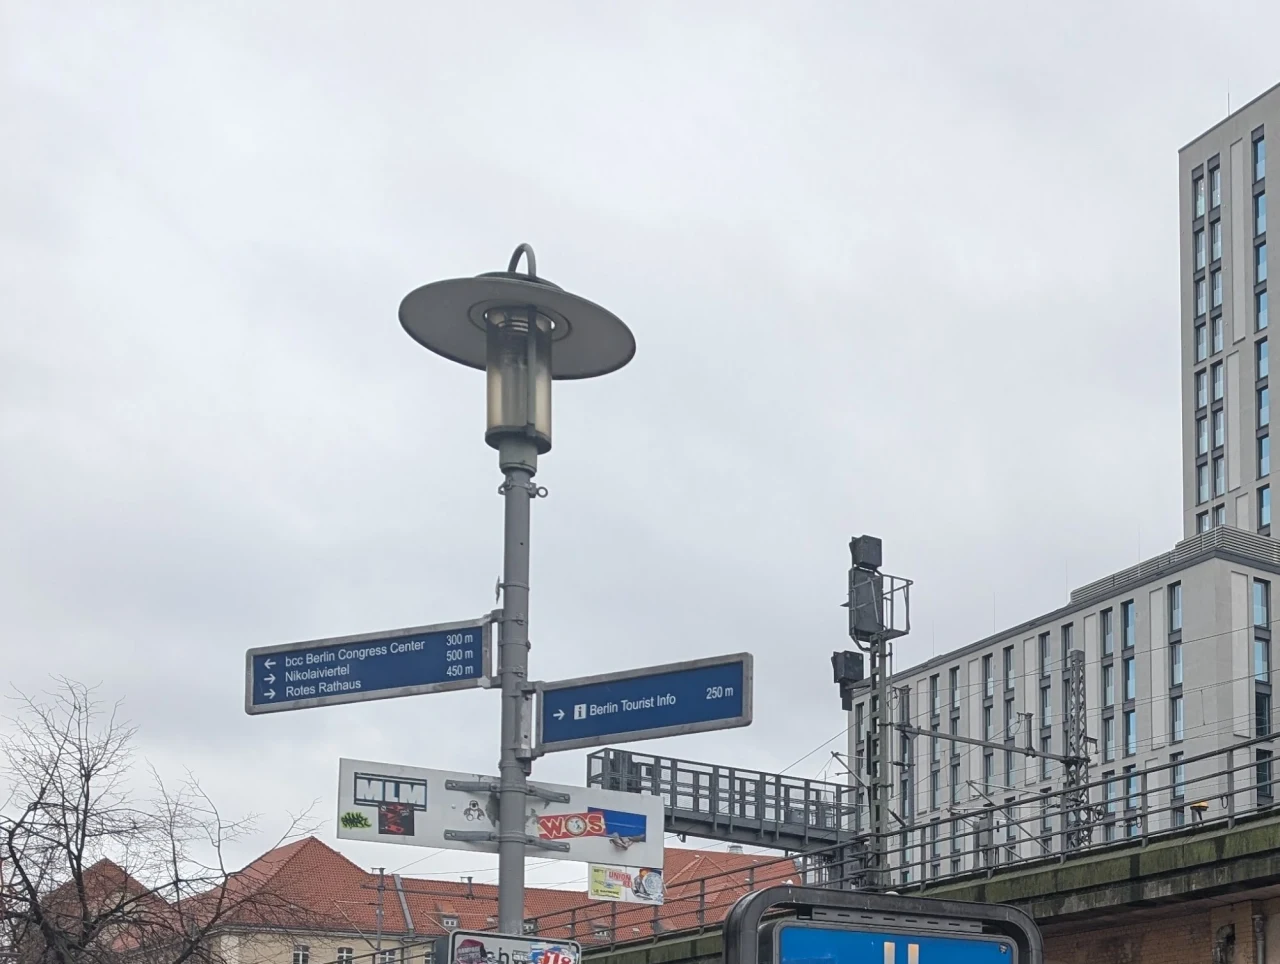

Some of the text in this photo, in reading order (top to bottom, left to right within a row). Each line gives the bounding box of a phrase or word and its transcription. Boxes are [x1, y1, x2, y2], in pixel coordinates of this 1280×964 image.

[446, 634, 473, 646] 300 m
[285, 640, 425, 667] bcc Berlin Congress Center
[446, 650, 473, 662] 500 m
[285, 664, 350, 682] Nikolaiviertel
[446, 666, 473, 677] 450 m
[286, 680, 361, 698] Rotes Rathaus
[706, 686, 733, 699] 250 m
[590, 694, 676, 716] Berlin Tourist Info
[609, 871, 632, 880] UNION
